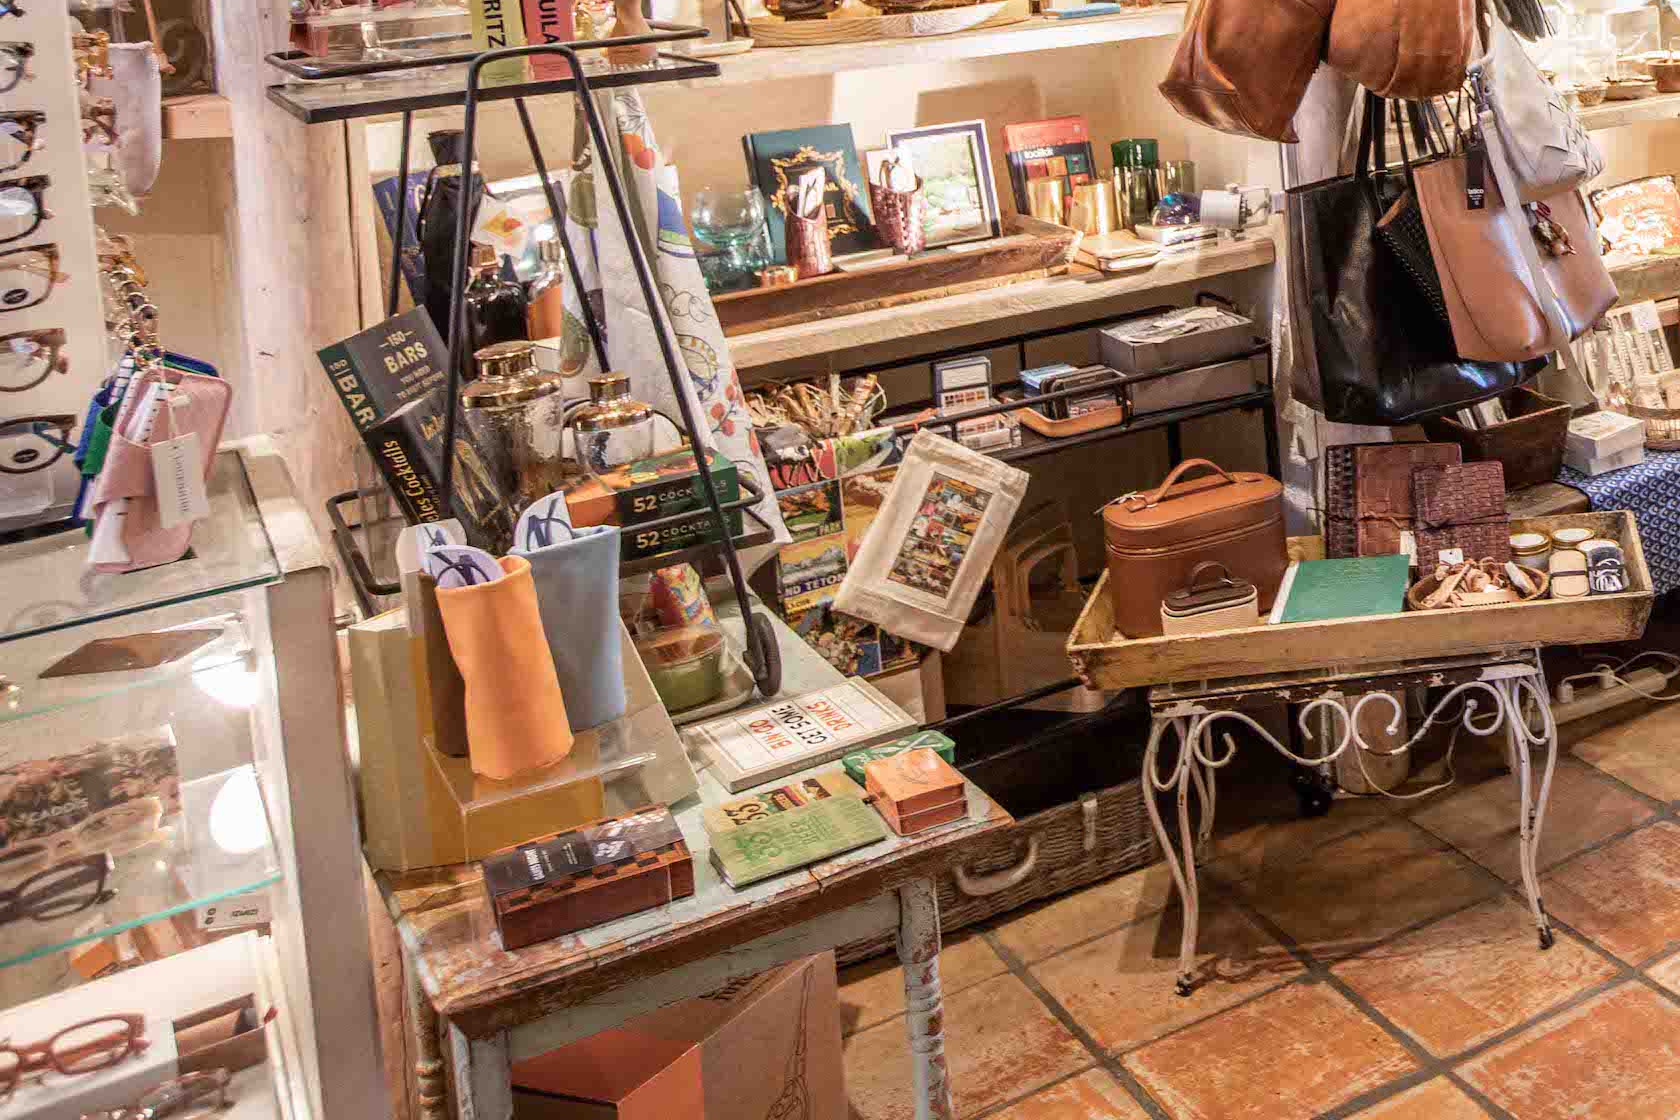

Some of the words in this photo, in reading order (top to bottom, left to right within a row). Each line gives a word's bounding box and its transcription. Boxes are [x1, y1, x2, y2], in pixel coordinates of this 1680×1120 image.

[383, 341, 429, 374] BARS
[336, 373, 377, 429] BAR
[383, 439, 425, 497] Cocktails
[633, 495, 657, 513] 52
[636, 530, 660, 549] 52
[807, 700, 853, 732] DRINKS
